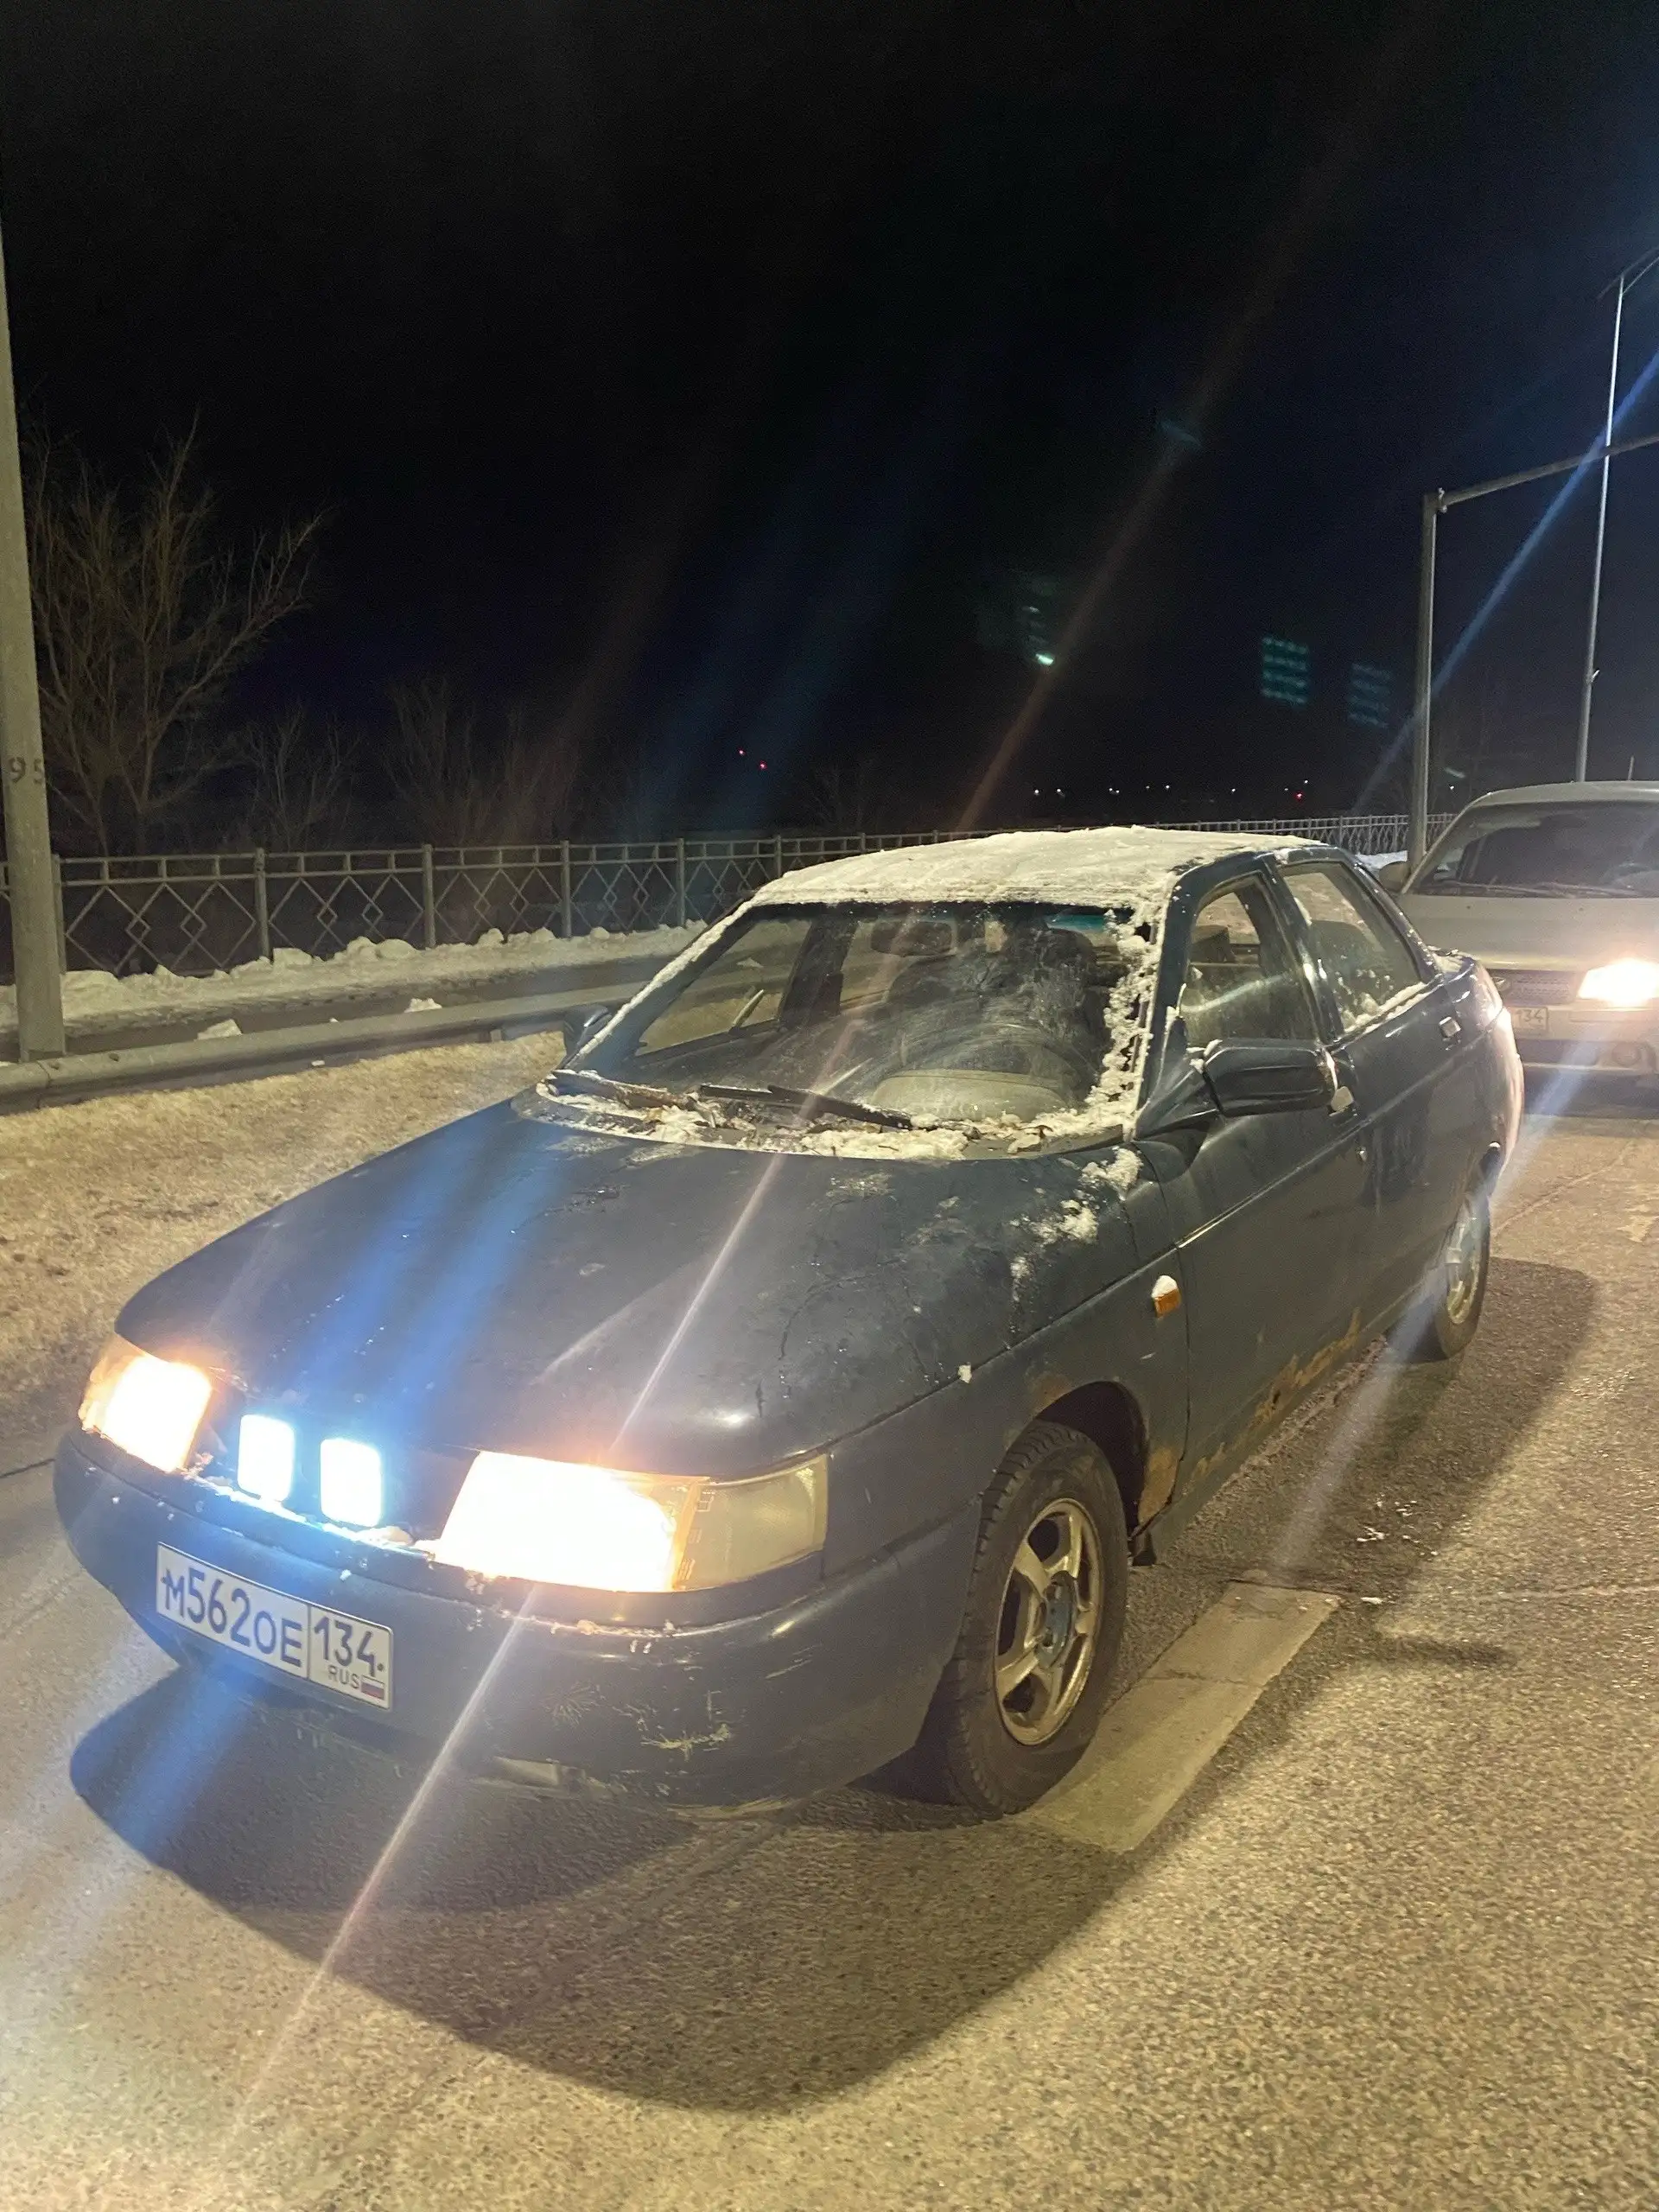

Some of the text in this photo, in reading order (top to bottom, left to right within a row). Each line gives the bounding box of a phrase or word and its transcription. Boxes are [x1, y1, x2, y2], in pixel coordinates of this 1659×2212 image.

[164, 1567, 375, 1677] М562ОЕ 134
[327, 1665, 360, 1690] RUS
